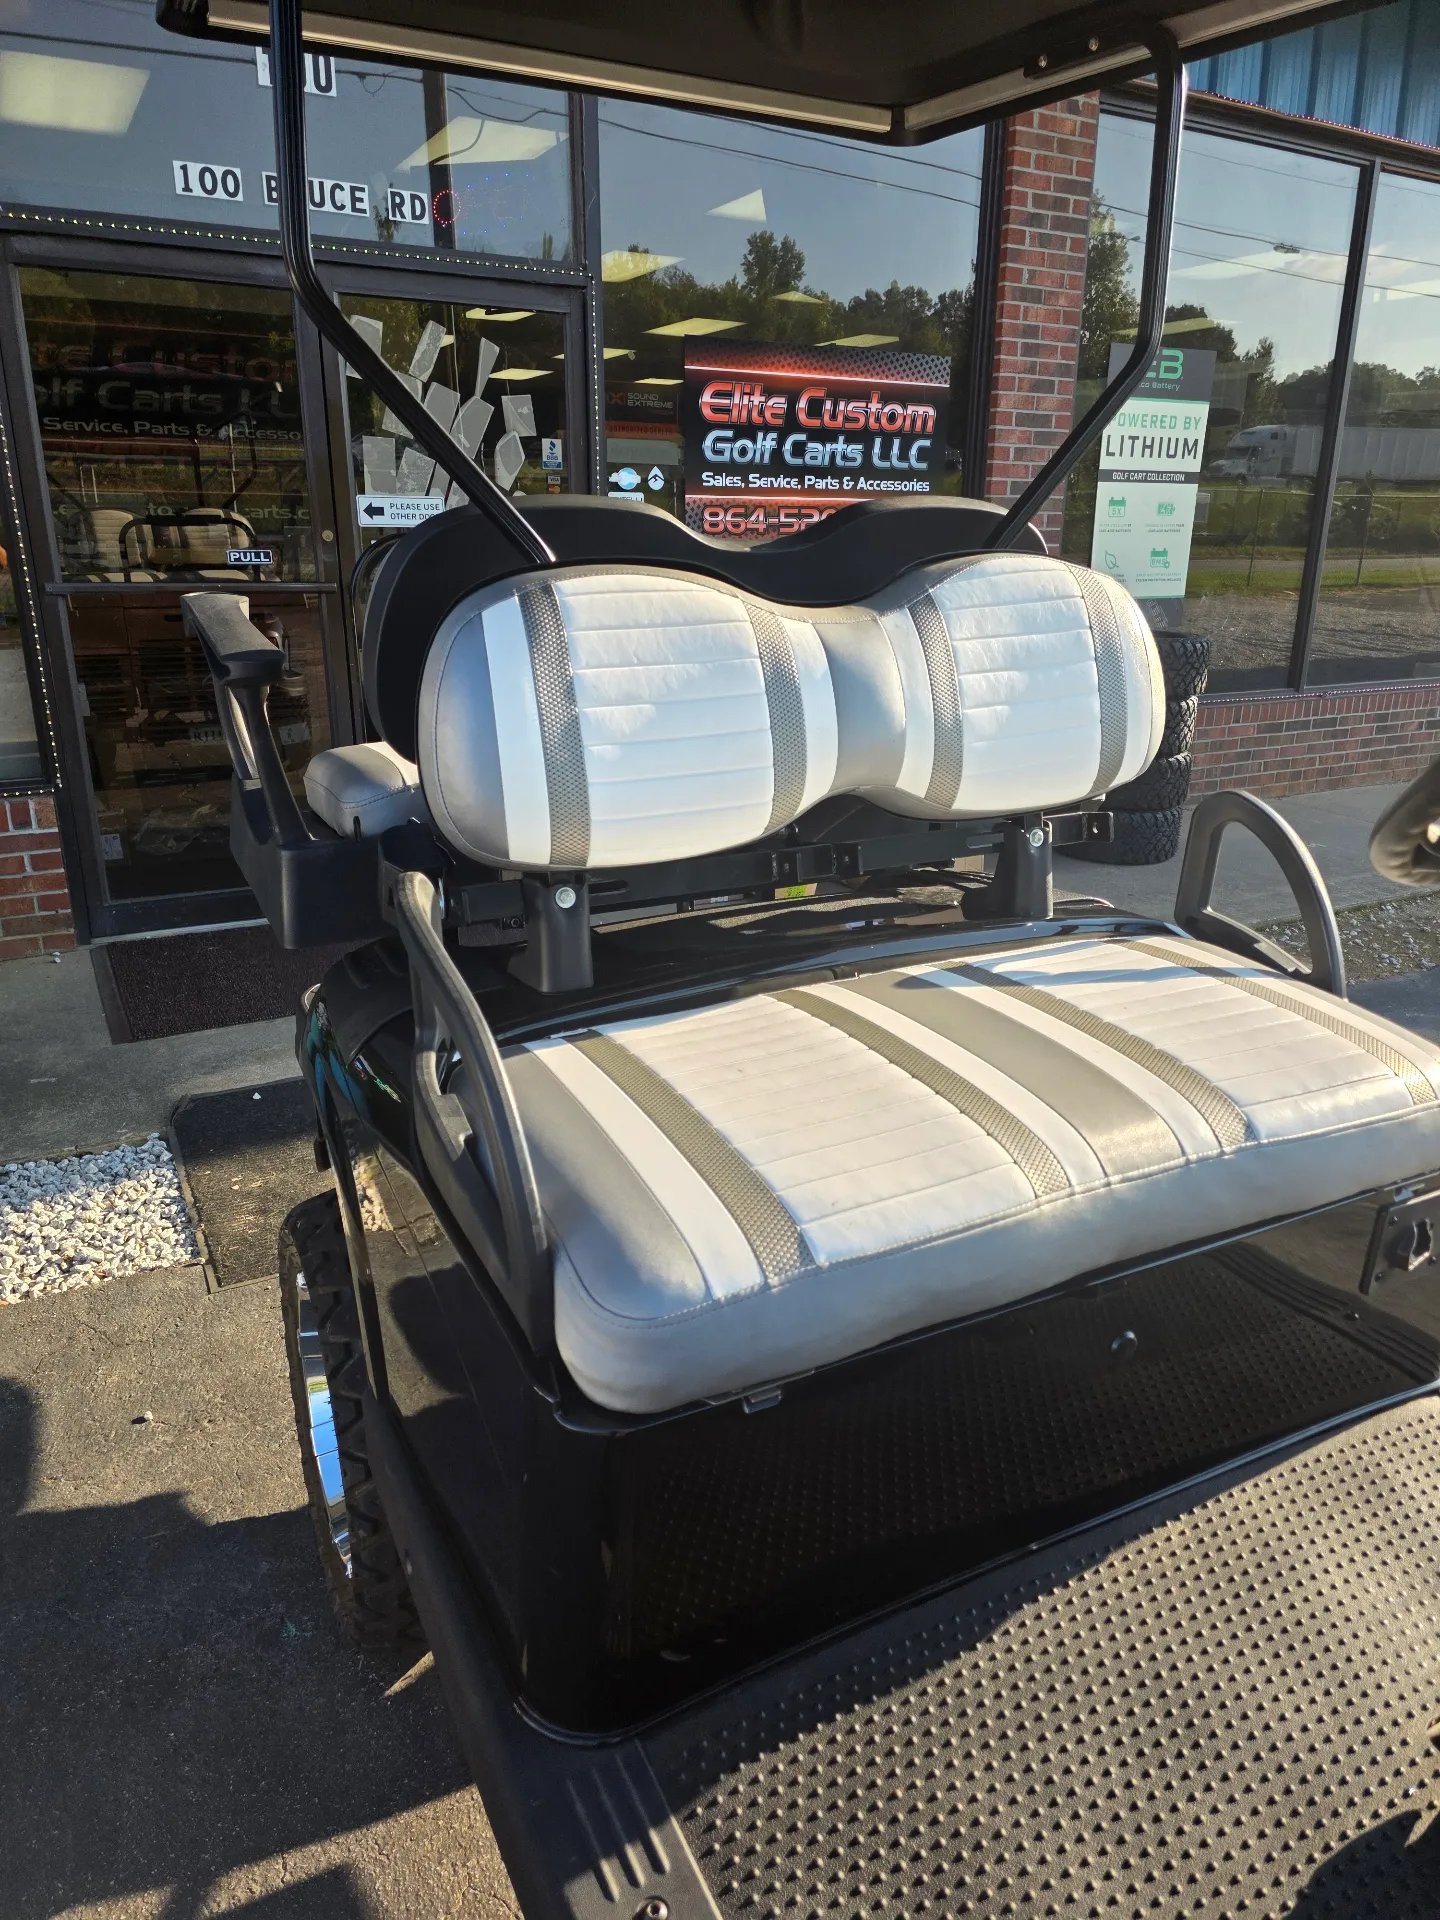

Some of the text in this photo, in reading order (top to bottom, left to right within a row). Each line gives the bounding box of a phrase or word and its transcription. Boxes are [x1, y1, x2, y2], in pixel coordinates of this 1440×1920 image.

[180, 163, 241, 199] 100
[265, 174, 368, 214] BUCE
[391, 190, 427, 221] RD
[1152, 382, 1181, 391] Battery
[98, 380, 224, 418] Carts
[627, 392, 659, 400] SOUND
[627, 399, 674, 409] EXTREME
[699, 380, 936, 434] Elite Custom
[43, 417, 129, 435] Service,
[134, 420, 190, 436] Parts
[1115, 412, 1202, 430] OWERED BY
[702, 428, 932, 471] Golf Carts LLC
[1105, 434, 1199, 459] LITHIUM
[701, 471, 745, 488] Sales,
[804, 475, 840, 490] Parts
[842, 478, 855, 490] &
[857, 477, 930, 492] Accessories
[1112, 471, 1185, 481] GOLF CART COLLECTION
[423, 503, 440, 511] USE
[229, 551, 271, 563] PULL
